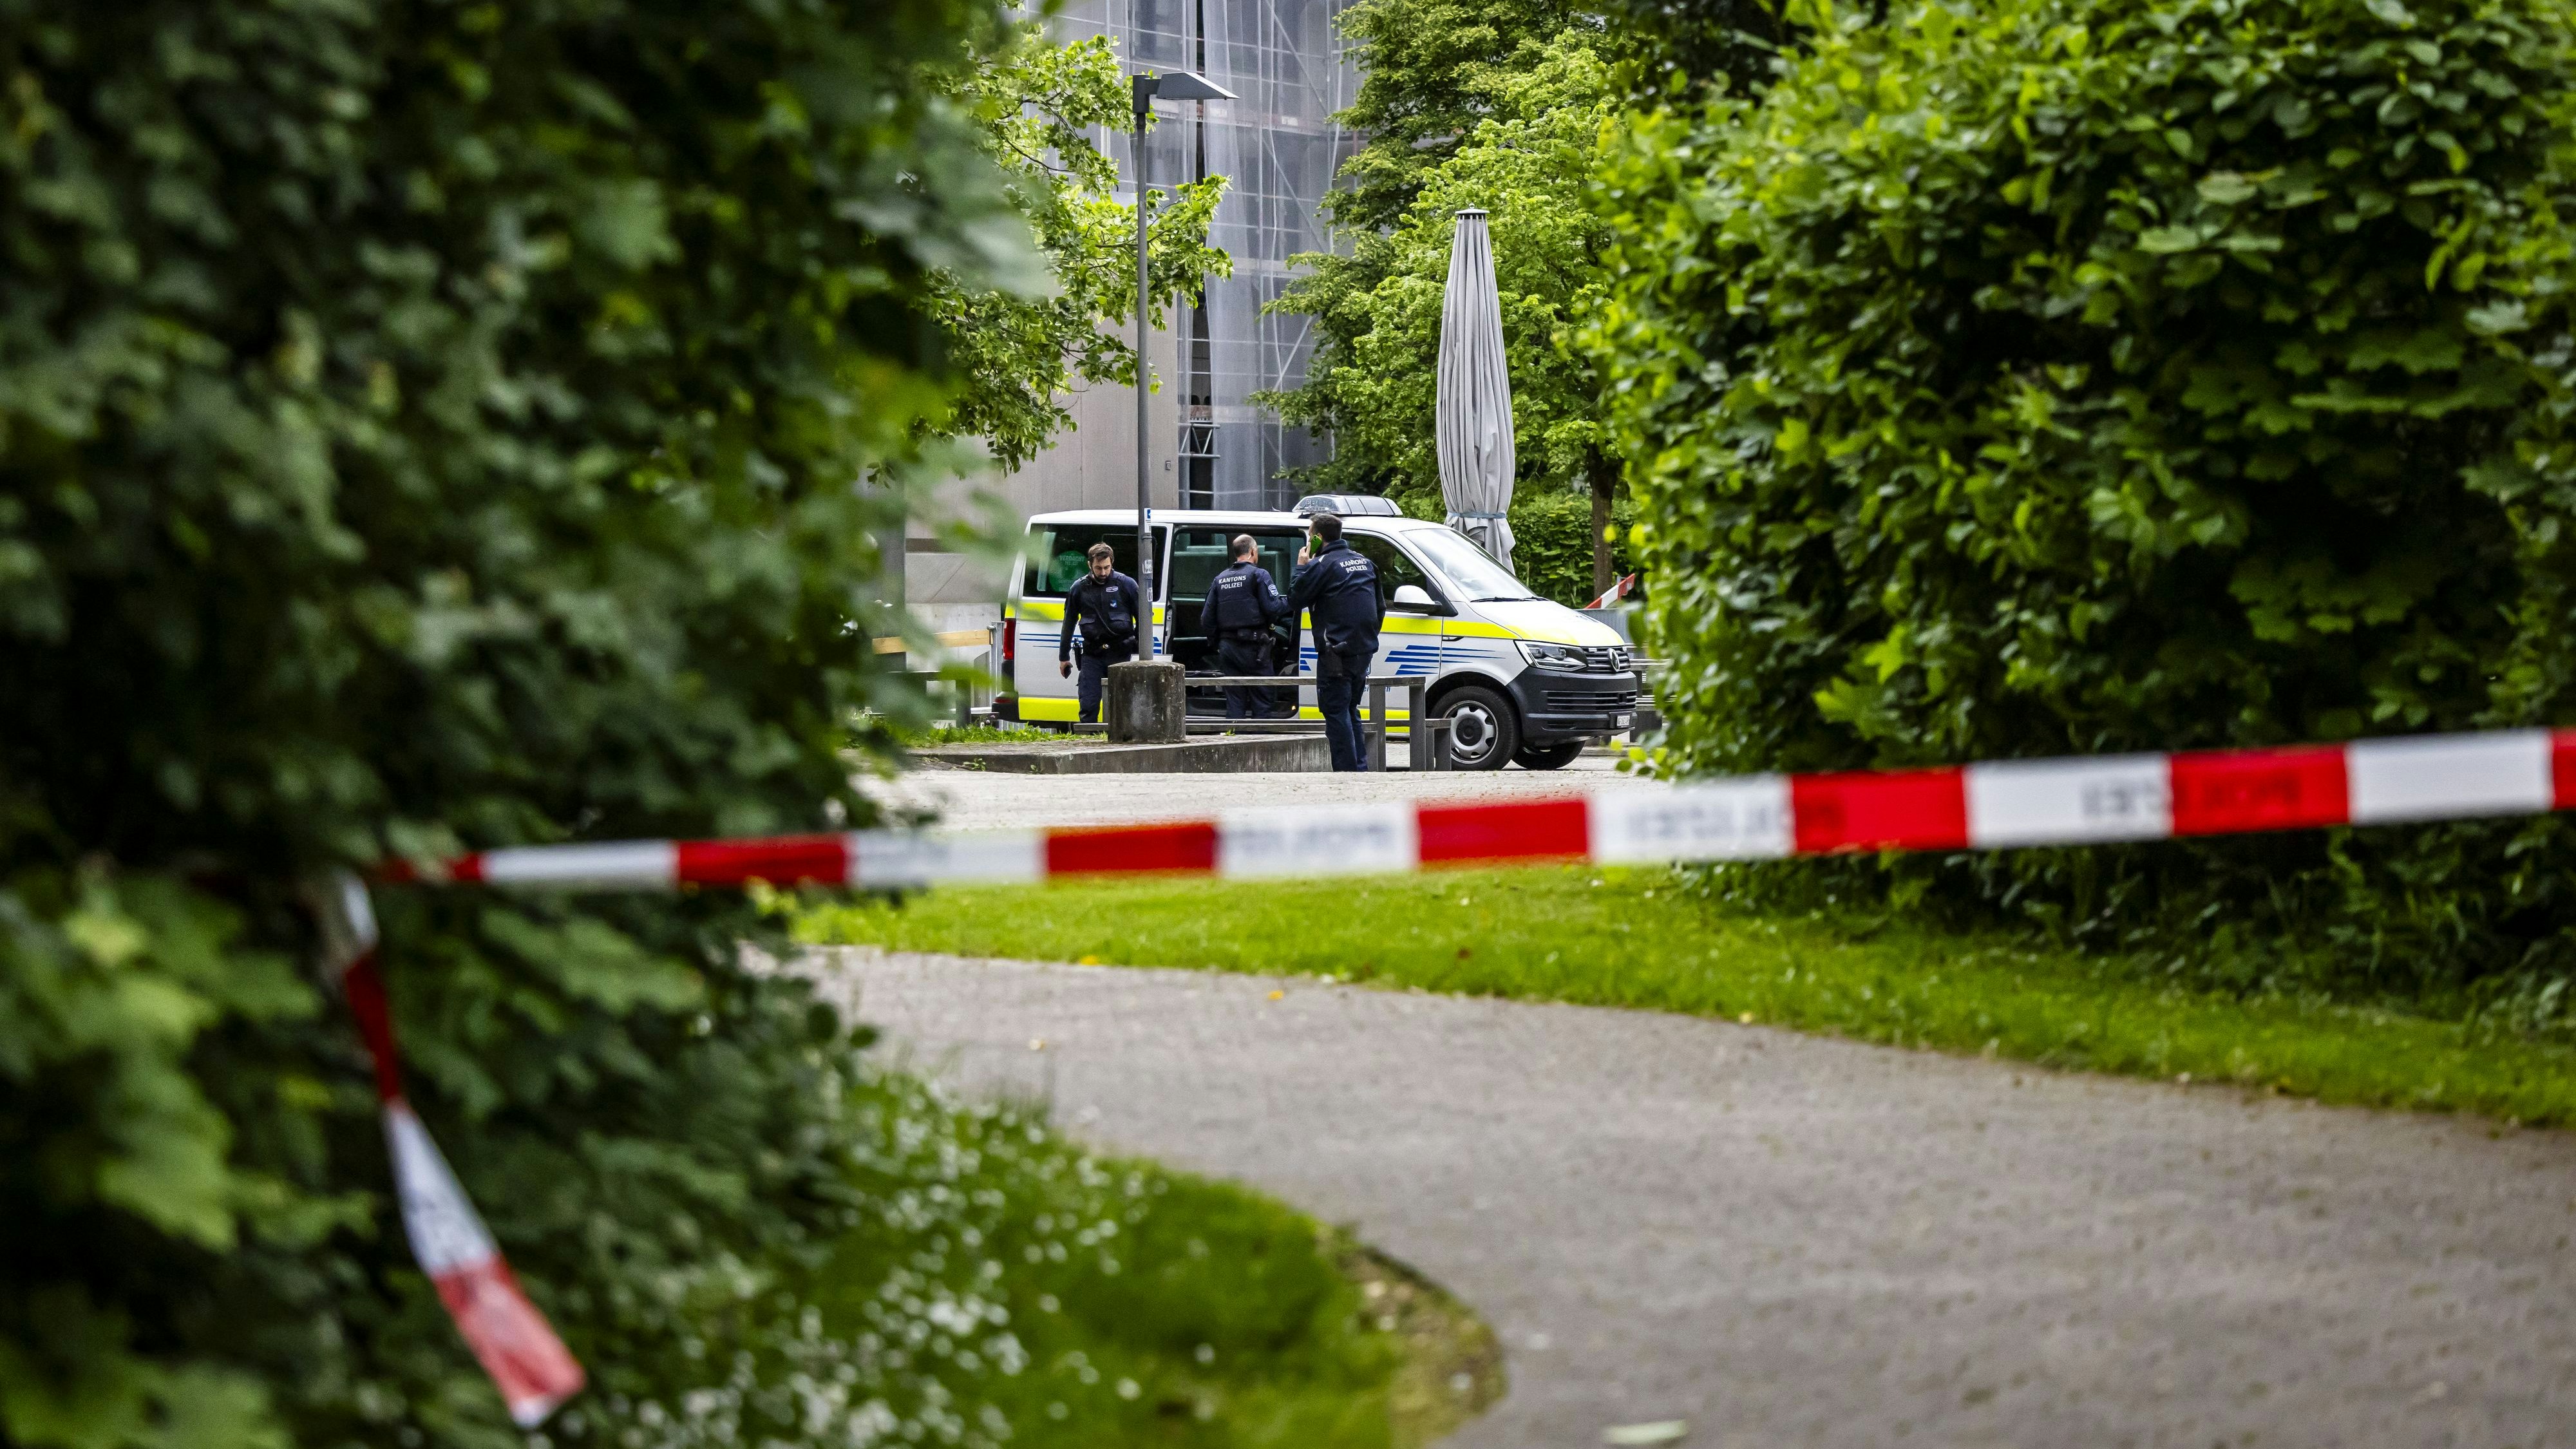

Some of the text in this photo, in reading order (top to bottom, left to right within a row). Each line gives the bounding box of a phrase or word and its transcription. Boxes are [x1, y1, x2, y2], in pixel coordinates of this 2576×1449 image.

[1340, 559, 1367, 567] KANTONS
[1345, 565, 1367, 573] POLIZEI
[1218, 575, 1246, 584] KANTONS
